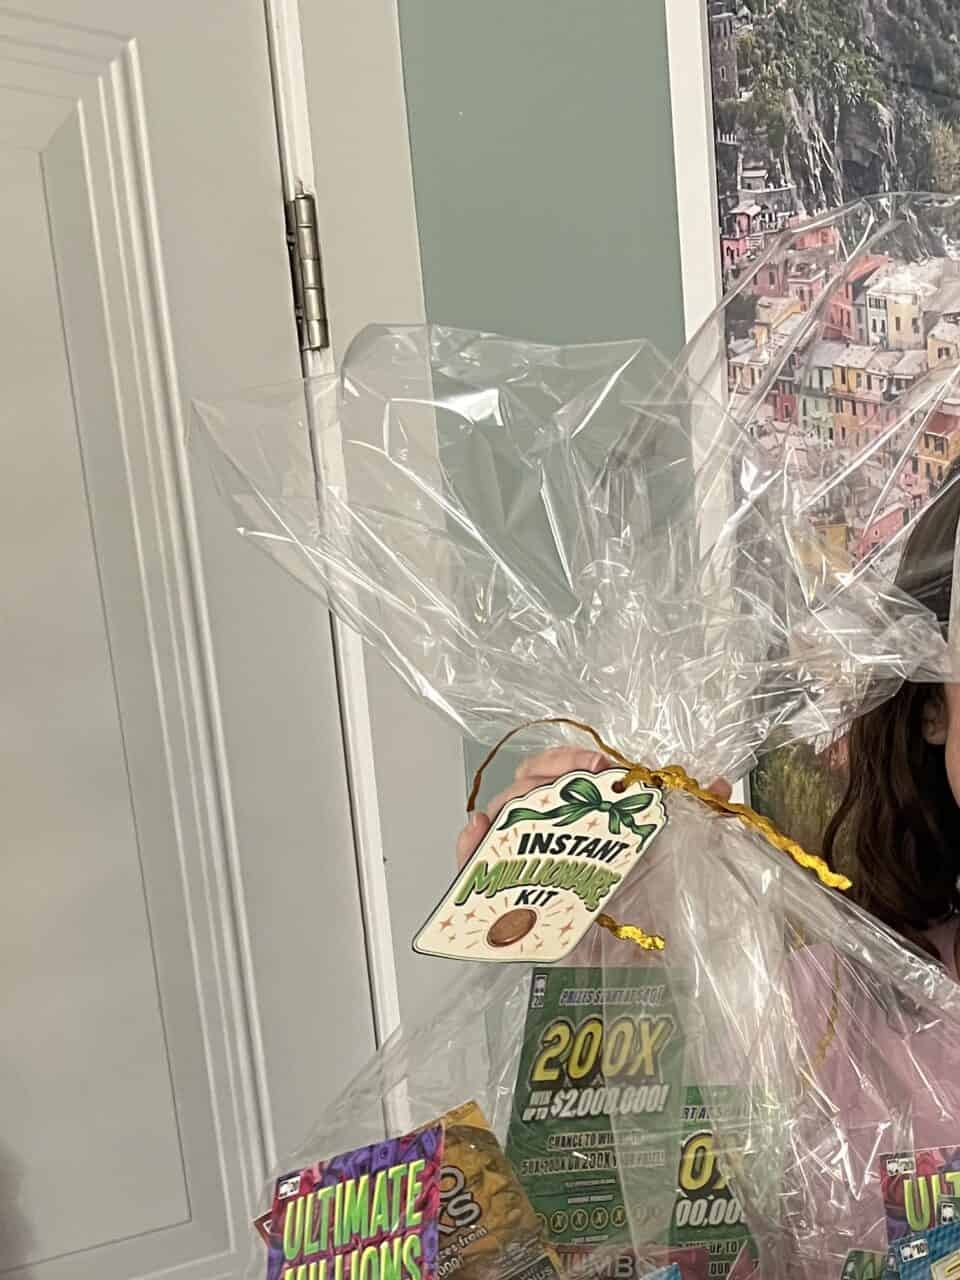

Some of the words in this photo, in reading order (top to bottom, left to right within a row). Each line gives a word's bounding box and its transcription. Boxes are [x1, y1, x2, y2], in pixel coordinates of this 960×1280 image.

[517, 832, 630, 865] INSTANT
[514, 889, 559, 908] KIT
[530, 1017, 668, 1085] 200X
[282, 1159, 425, 1261] ULTIMATE
